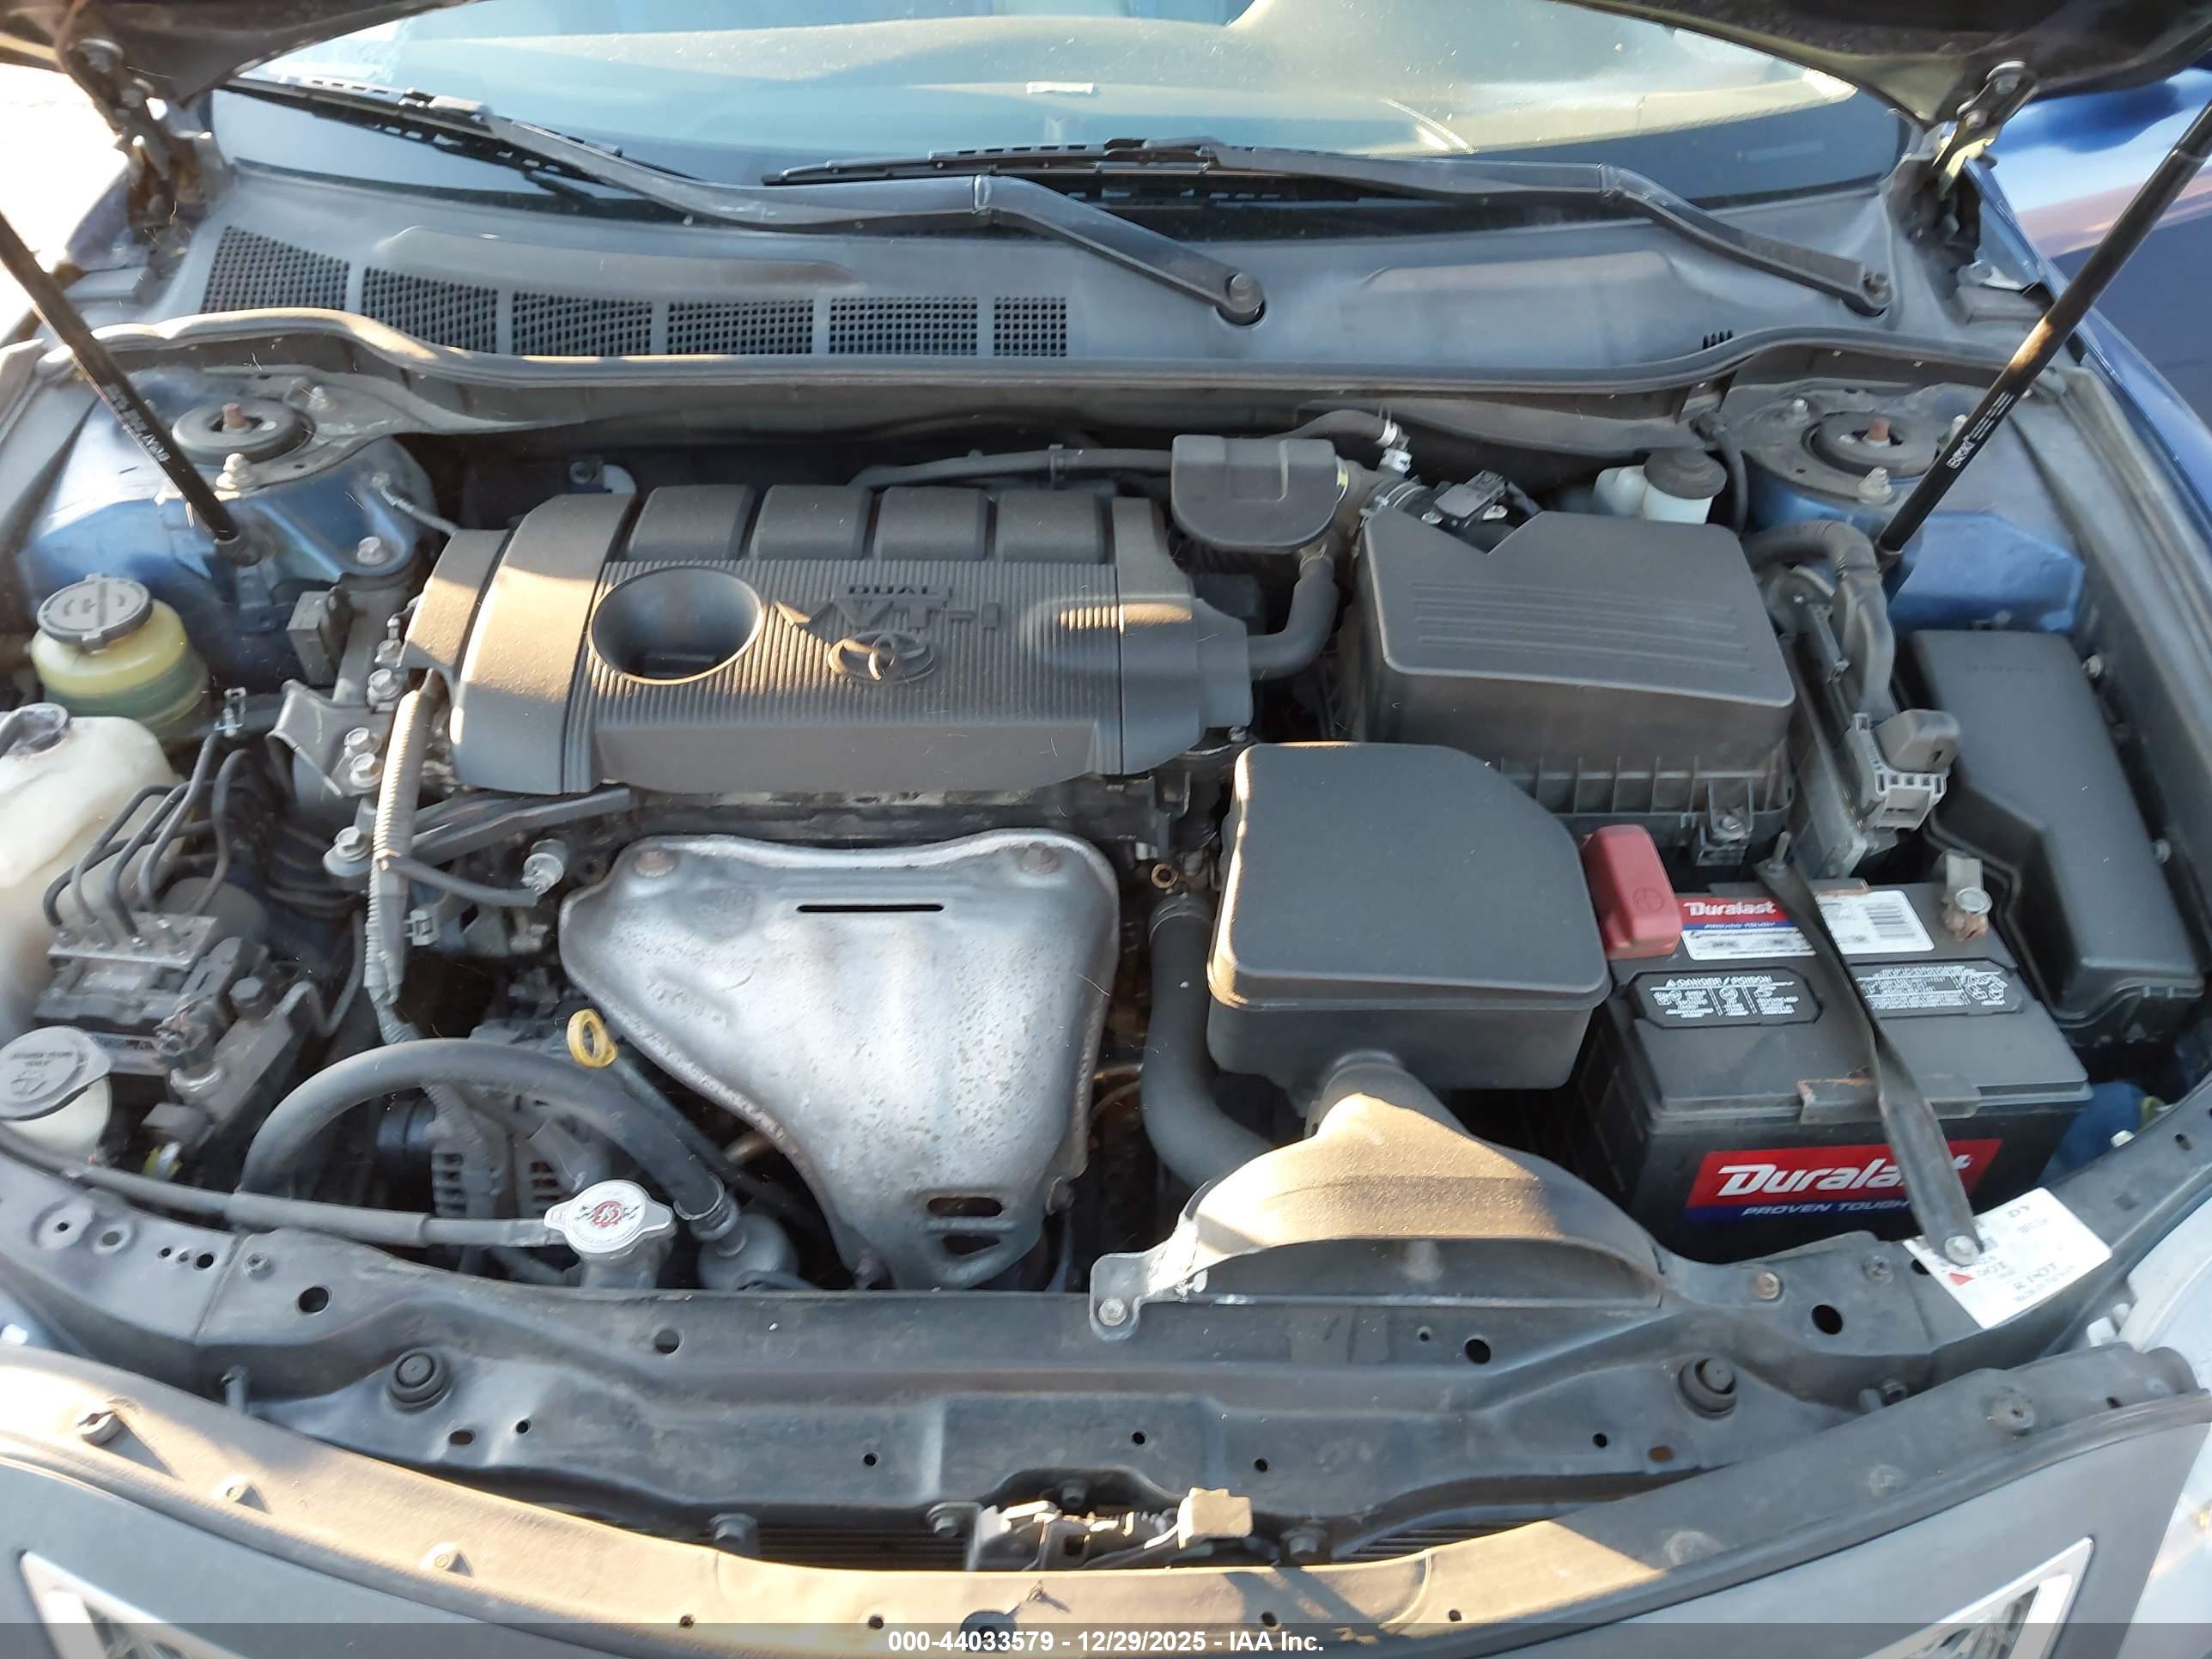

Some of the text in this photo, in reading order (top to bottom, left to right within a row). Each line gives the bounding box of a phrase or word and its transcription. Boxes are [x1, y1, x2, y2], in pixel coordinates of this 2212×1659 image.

[845, 586, 941, 596] DUAL
[1684, 901, 1777, 916] Duralast
[1741, 1203, 1832, 1217] PROVEN
